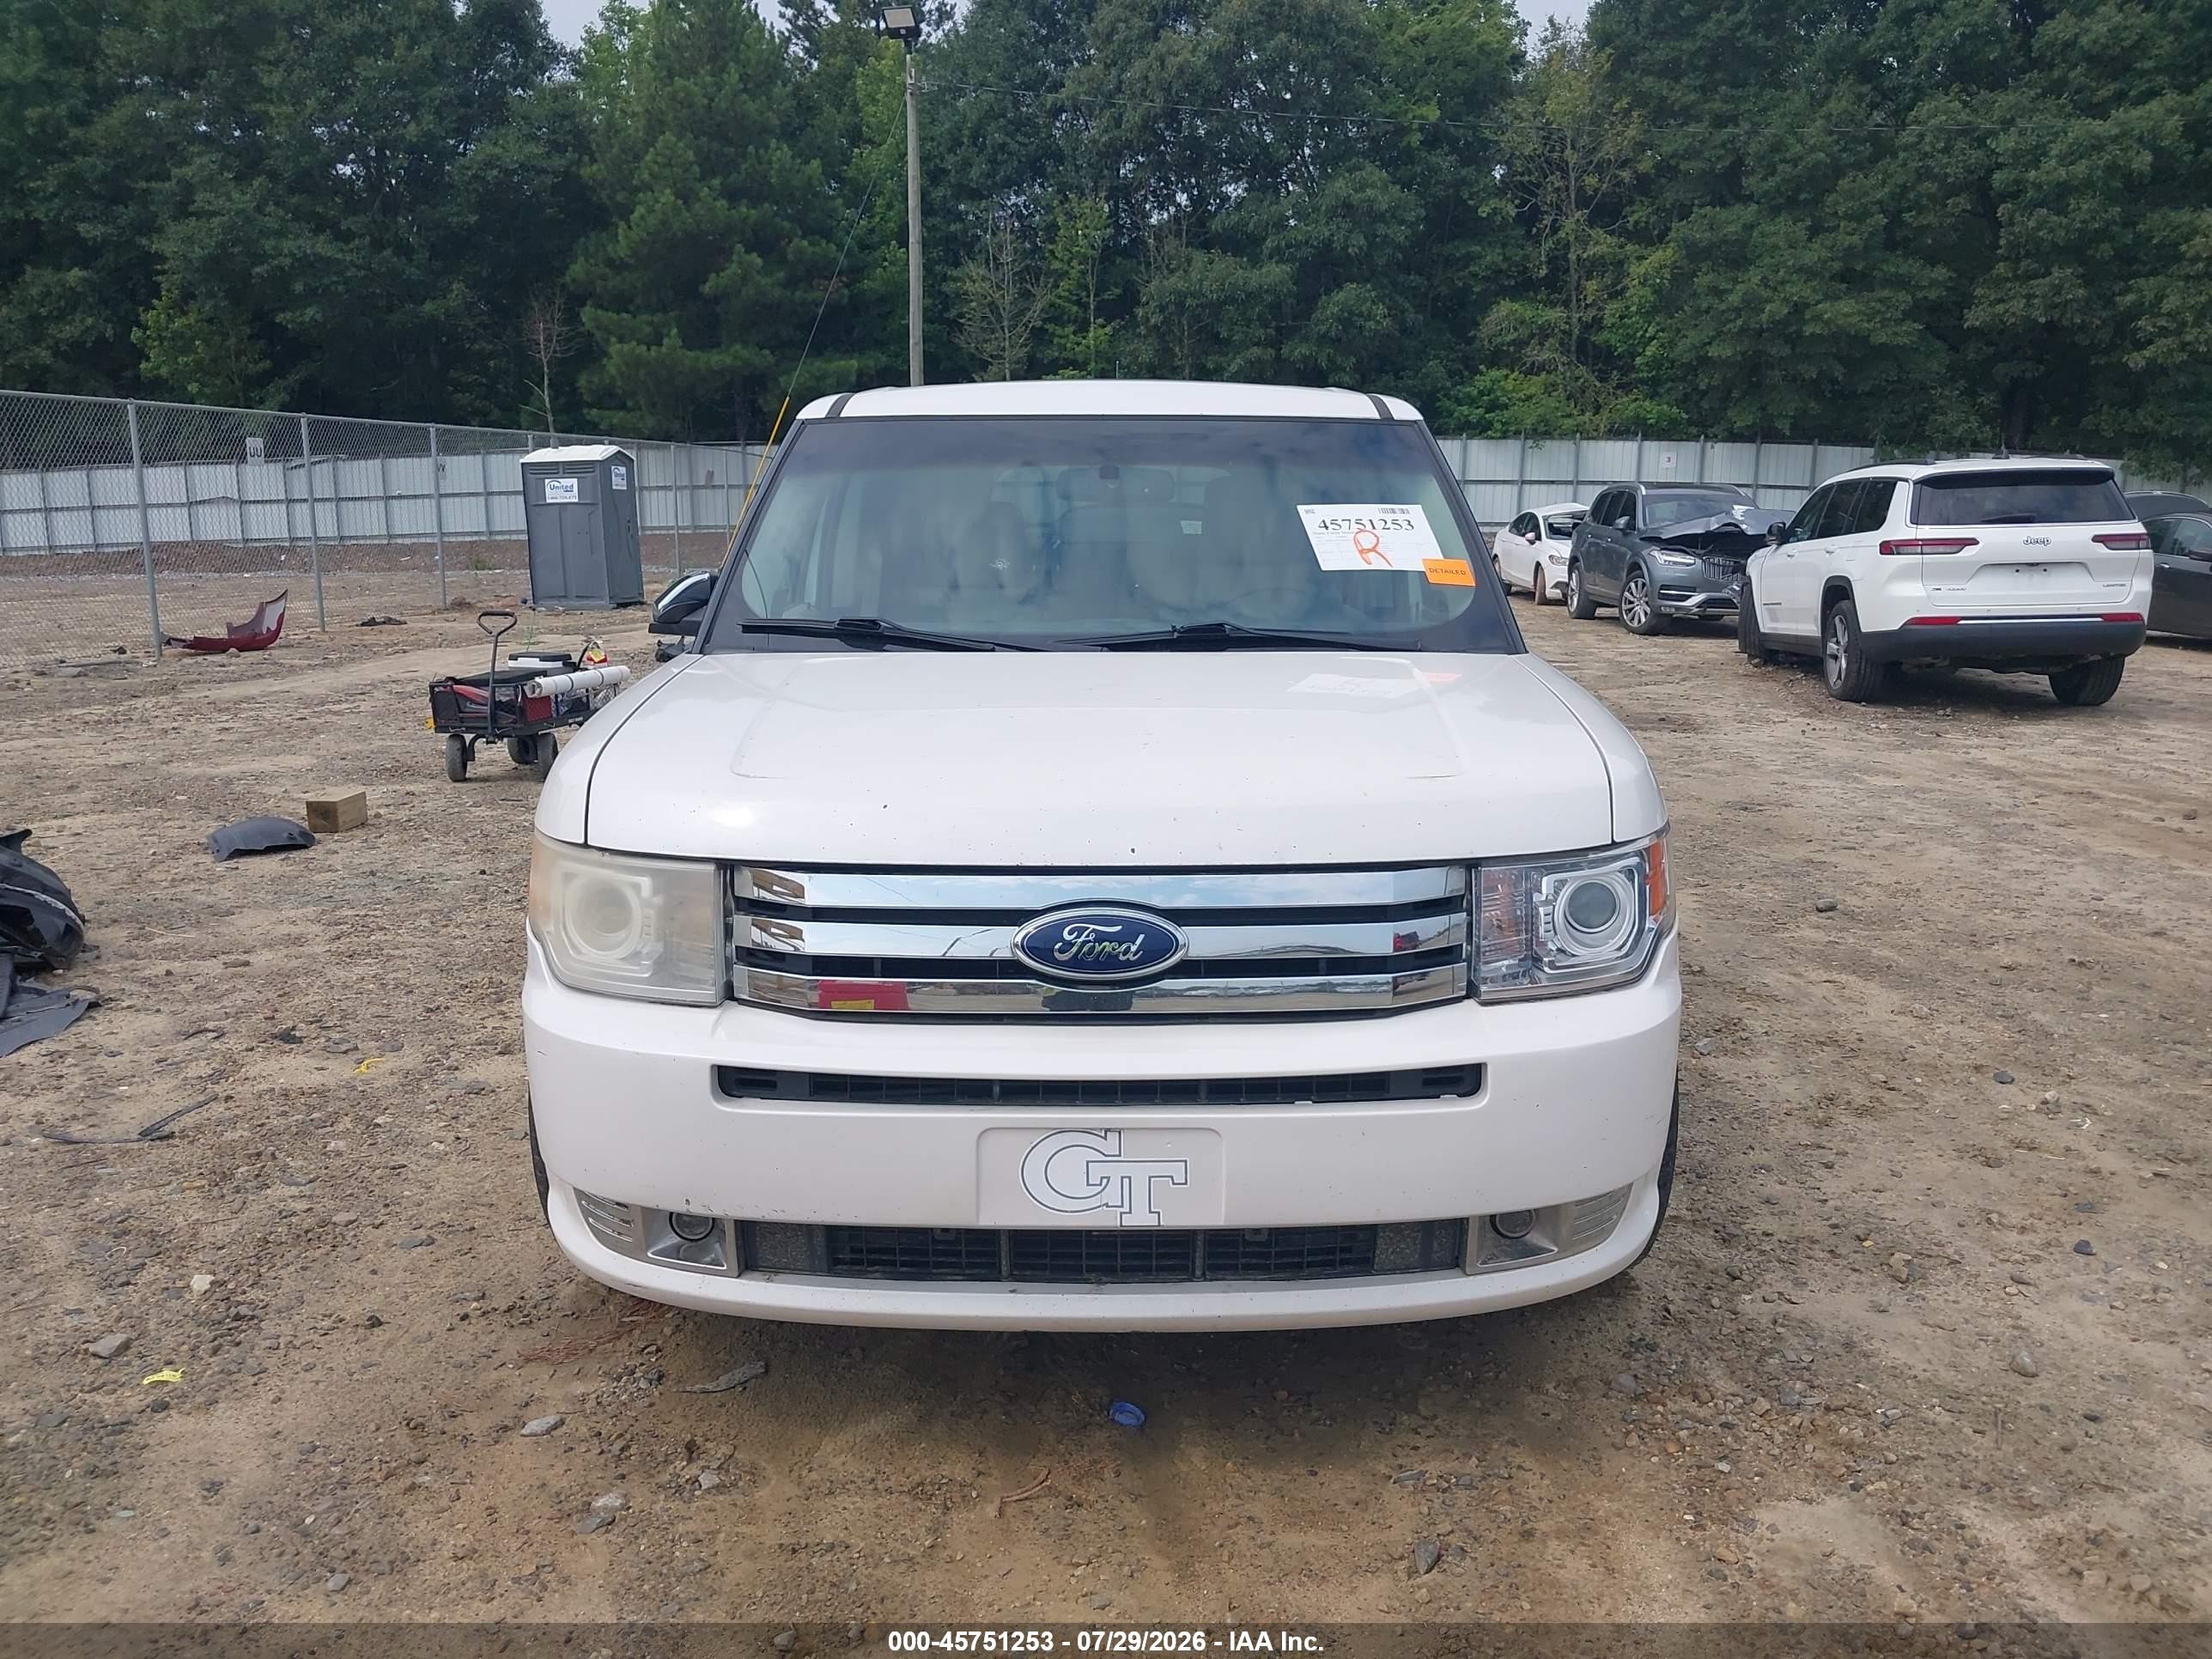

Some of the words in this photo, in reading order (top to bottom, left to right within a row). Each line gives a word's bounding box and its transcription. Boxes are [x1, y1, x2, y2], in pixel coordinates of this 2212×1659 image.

[249, 446, 262, 458] UU
[1317, 518, 1414, 531] 45751253
[1353, 529, 1394, 568] R
[2022, 536, 2051, 547] Jeep
[1054, 923, 1146, 961] Ford
[1021, 1128, 1188, 1227] GT
